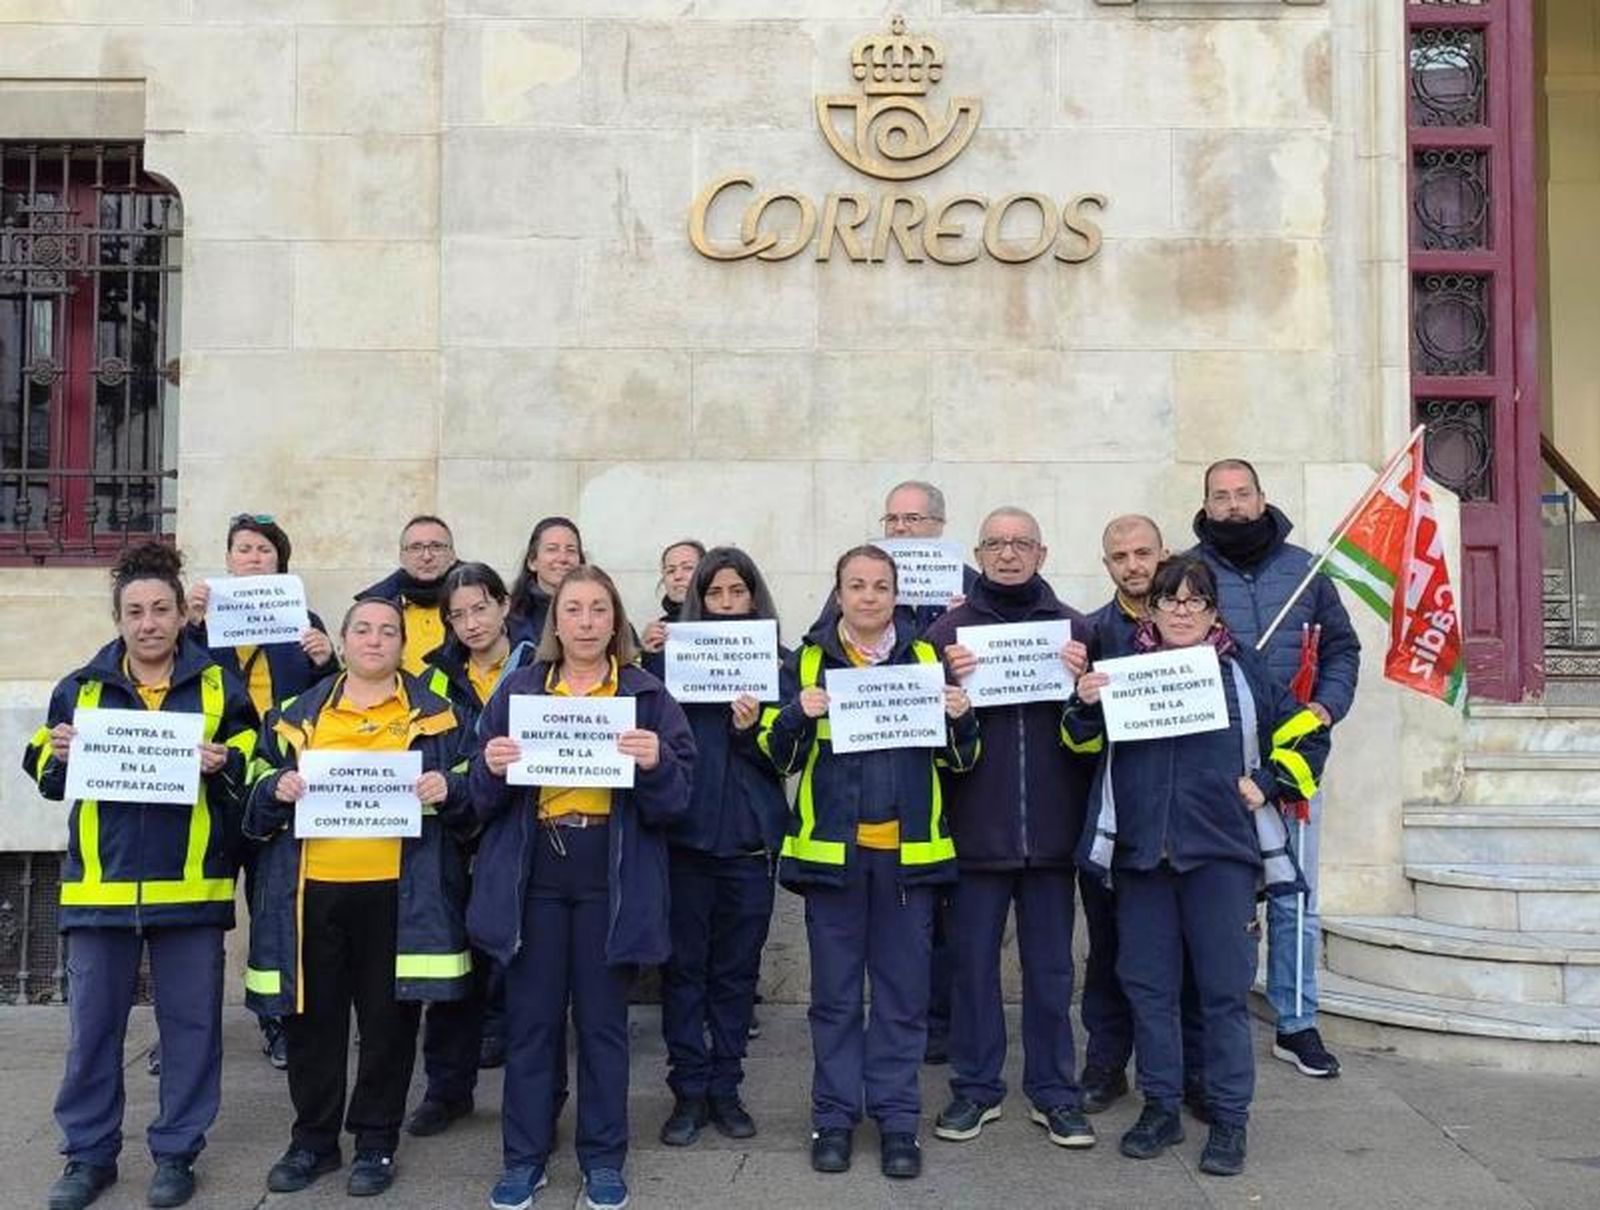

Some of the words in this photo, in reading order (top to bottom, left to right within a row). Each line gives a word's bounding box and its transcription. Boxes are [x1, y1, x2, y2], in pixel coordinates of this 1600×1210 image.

[688, 174, 1109, 265] CORREOS
[892, 550, 930, 558] CONTRA
[233, 588, 272, 598] CONTRA
[274, 587, 286, 596] EL
[217, 603, 256, 611] BRUTAL
[259, 599, 301, 609] RECORTE
[247, 615, 260, 623] EN
[263, 614, 276, 622] LA
[694, 637, 739, 646] CONTRA
[742, 637, 754, 645] EL
[988, 638, 1034, 648] CONTRA
[1036, 638, 1050, 646] EL
[676, 652, 722, 662] BRUTAL
[723, 651, 771, 661] RECORTE
[978, 655, 1014, 664] RUTAL
[1018, 652, 1060, 662] RECORT
[709, 668, 725, 677] EN
[728, 668, 741, 676] LA
[1005, 670, 1019, 678] EN
[1022, 669, 1037, 677] LA
[1128, 666, 1177, 681] CONTRA
[1179, 664, 1194, 675] EL
[858, 682, 905, 693] CONTRA
[907, 681, 922, 691] EL
[1112, 687, 1159, 699] BRUTAL
[1161, 678, 1215, 693] RECORTE
[840, 699, 885, 710] BRUTAL
[888, 696, 939, 706] RECORTE
[1149, 702, 1166, 711] EN
[1168, 699, 1184, 709] LA
[542, 714, 593, 724] CONTRA
[595, 715, 611, 724] EL
[875, 715, 891, 724] EN
[894, 713, 909, 722] LA
[107, 726, 158, 738] CONTRA
[161, 729, 176, 739] EL
[521, 730, 571, 740] BRUTAL
[574, 731, 622, 741] RECORT
[83, 743, 134, 755] BRUTAL
[137, 745, 195, 757] RECORTE
[558, 748, 574, 757] EN
[578, 748, 593, 757] LA
[121, 762, 137, 772] EN
[141, 763, 157, 774] LA
[328, 767, 378, 777] CONTRA
[382, 768, 396, 777] EL
[308, 784, 357, 793] BRUTAL
[360, 784, 415, 793] RECORTE
[345, 800, 361, 809] EN
[364, 800, 380, 809] LA
